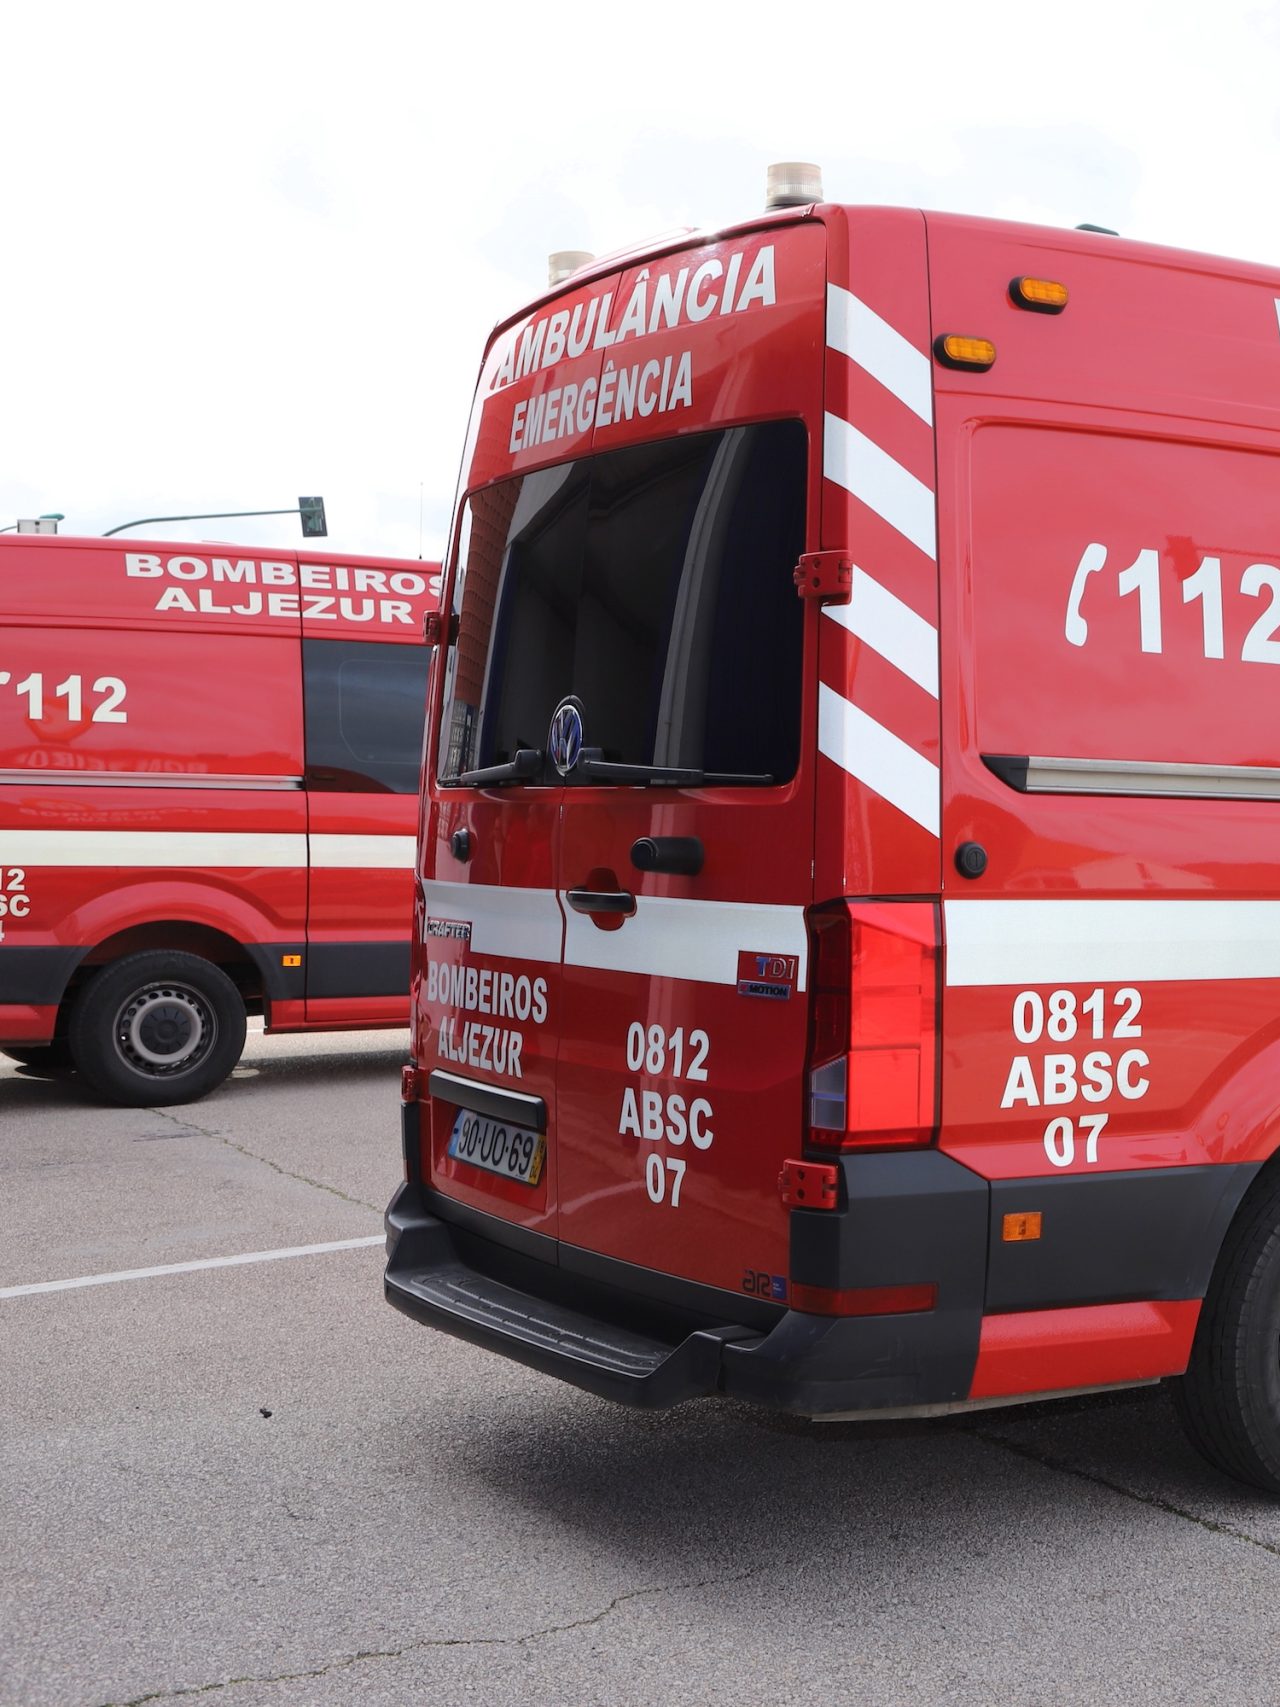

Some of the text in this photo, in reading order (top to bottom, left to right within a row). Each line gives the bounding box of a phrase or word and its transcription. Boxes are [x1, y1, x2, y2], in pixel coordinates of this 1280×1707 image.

[489, 244, 777, 391] AMBULÂNCIA
[508, 350, 693, 454] EMERGÊNCIA
[154, 586, 415, 624] ALJEZUR
[16, 672, 128, 724] 112
[427, 920, 471, 939] CRAFTER
[427, 960, 549, 1025] BOMBEIROS
[754, 956, 796, 980] TDI
[1012, 987, 1143, 1044] 0812
[437, 1015, 524, 1079] ALJEZUR
[626, 1021, 711, 1082] 0812
[1000, 1048, 1151, 1109] ABSC
[618, 1086, 715, 1150] ABSC
[1043, 1113, 1110, 1168] 07
[645, 1152, 688, 1208] 07
